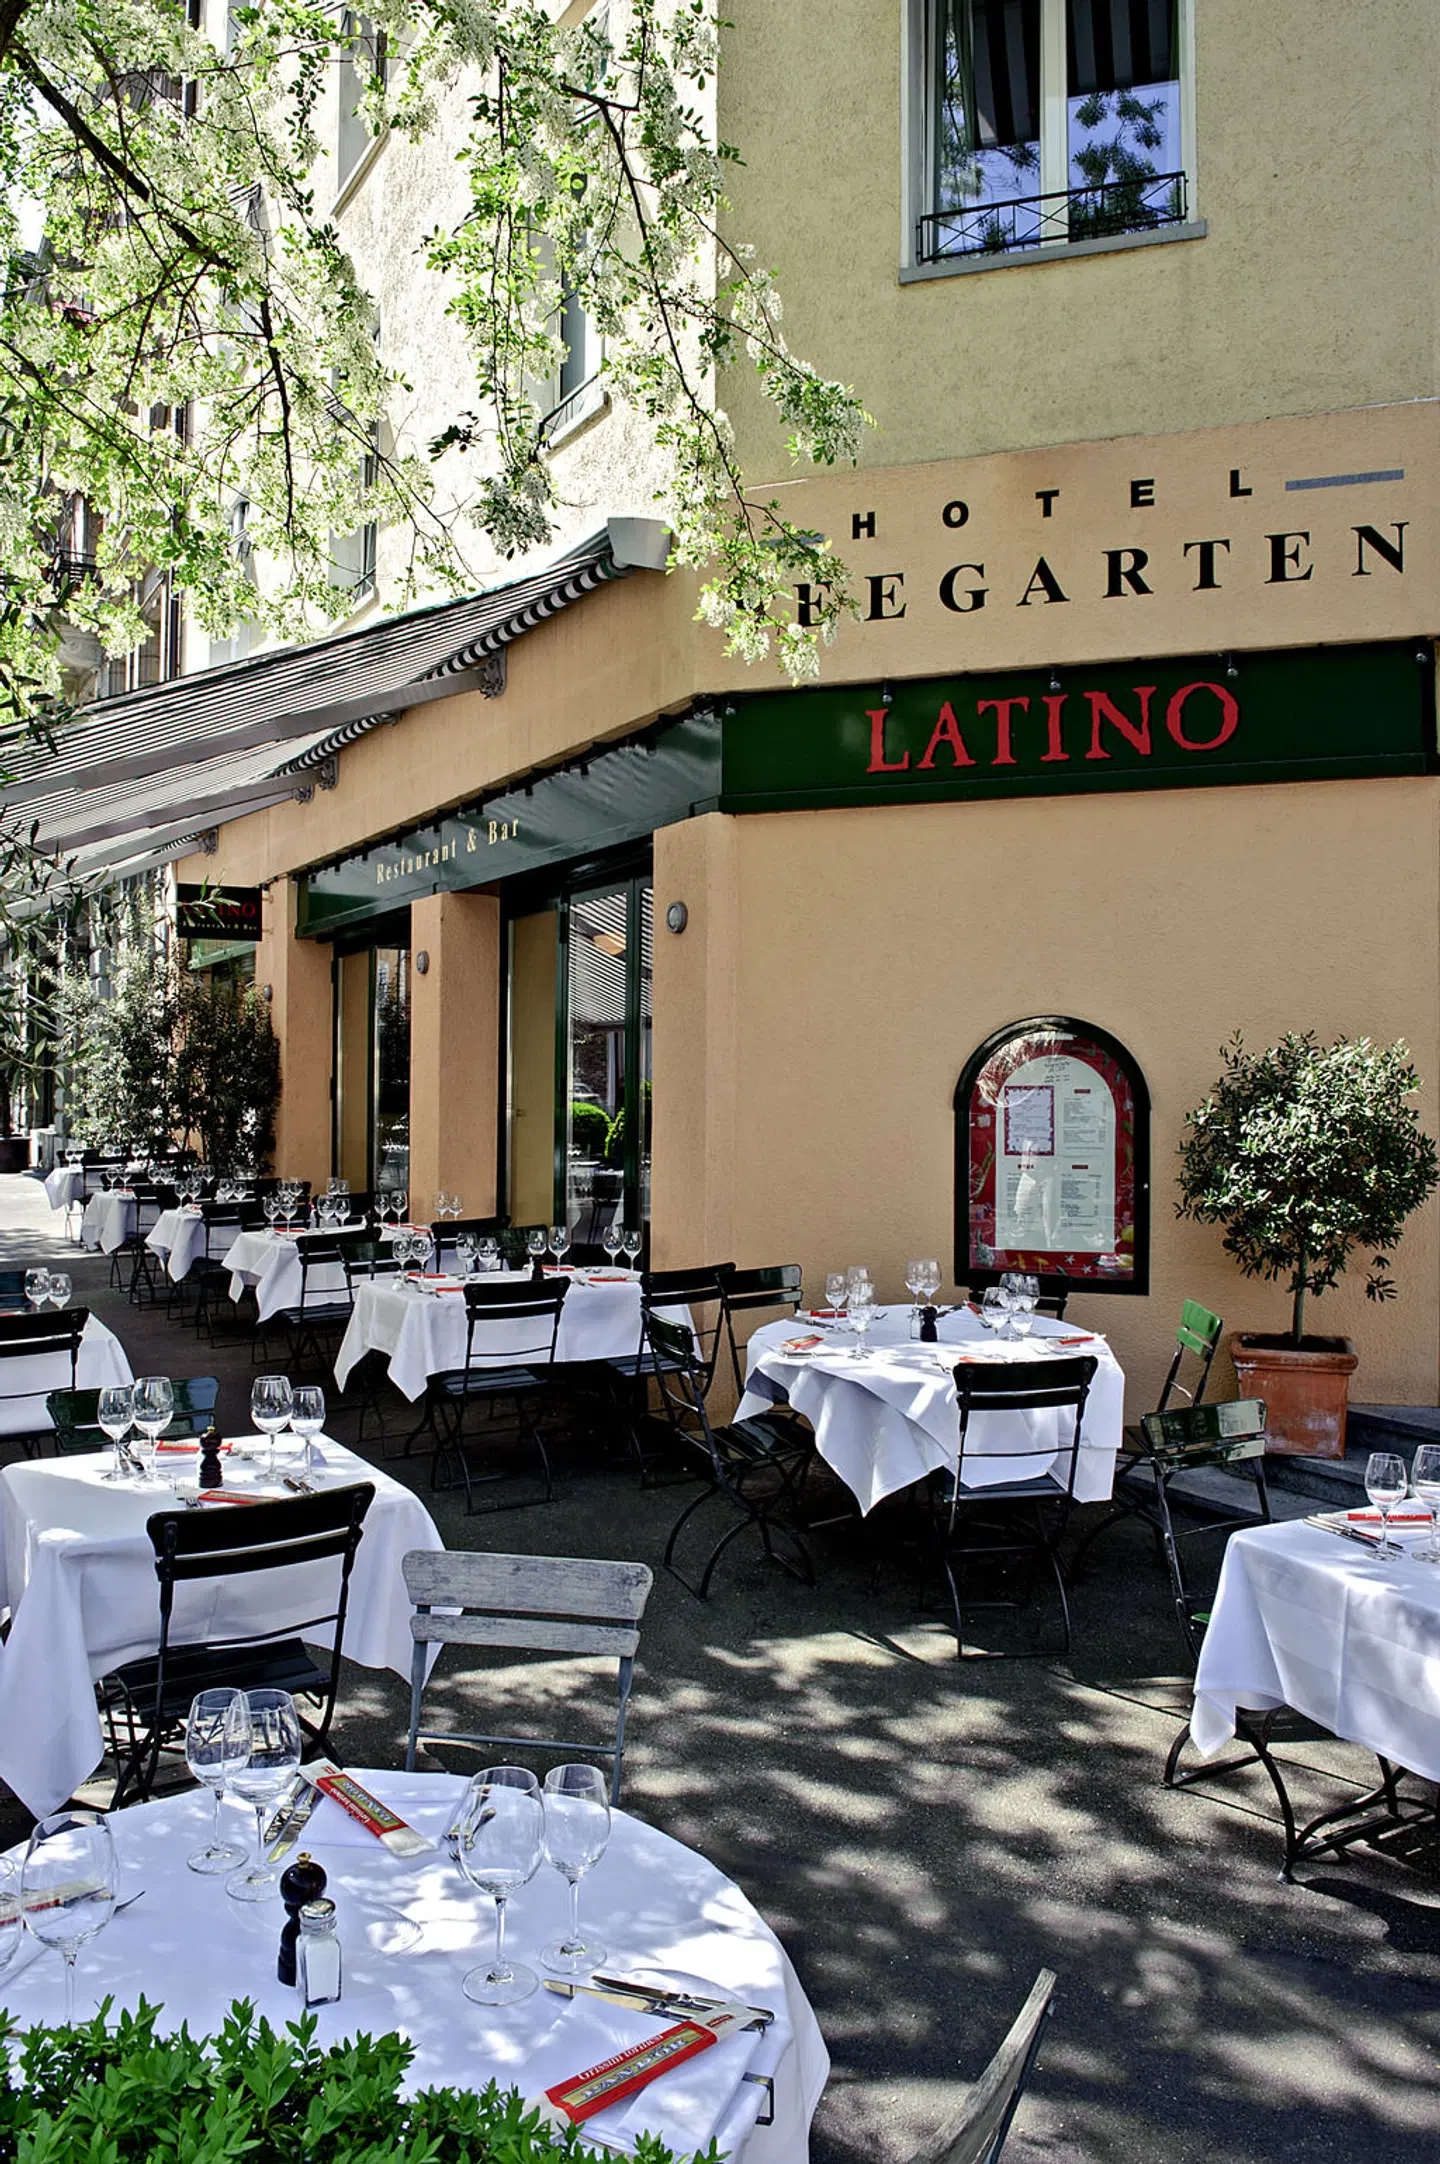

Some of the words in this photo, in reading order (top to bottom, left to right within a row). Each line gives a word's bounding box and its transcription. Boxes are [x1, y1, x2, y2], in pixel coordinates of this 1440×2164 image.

[852, 469, 1253, 540] HOTEL
[728, 522, 1409, 628] EEGARTEN
[865, 681, 1240, 773] LATINO
[376, 837, 456, 885] Restaurant
[466, 827, 477, 853] &
[488, 817, 519, 846] Bar
